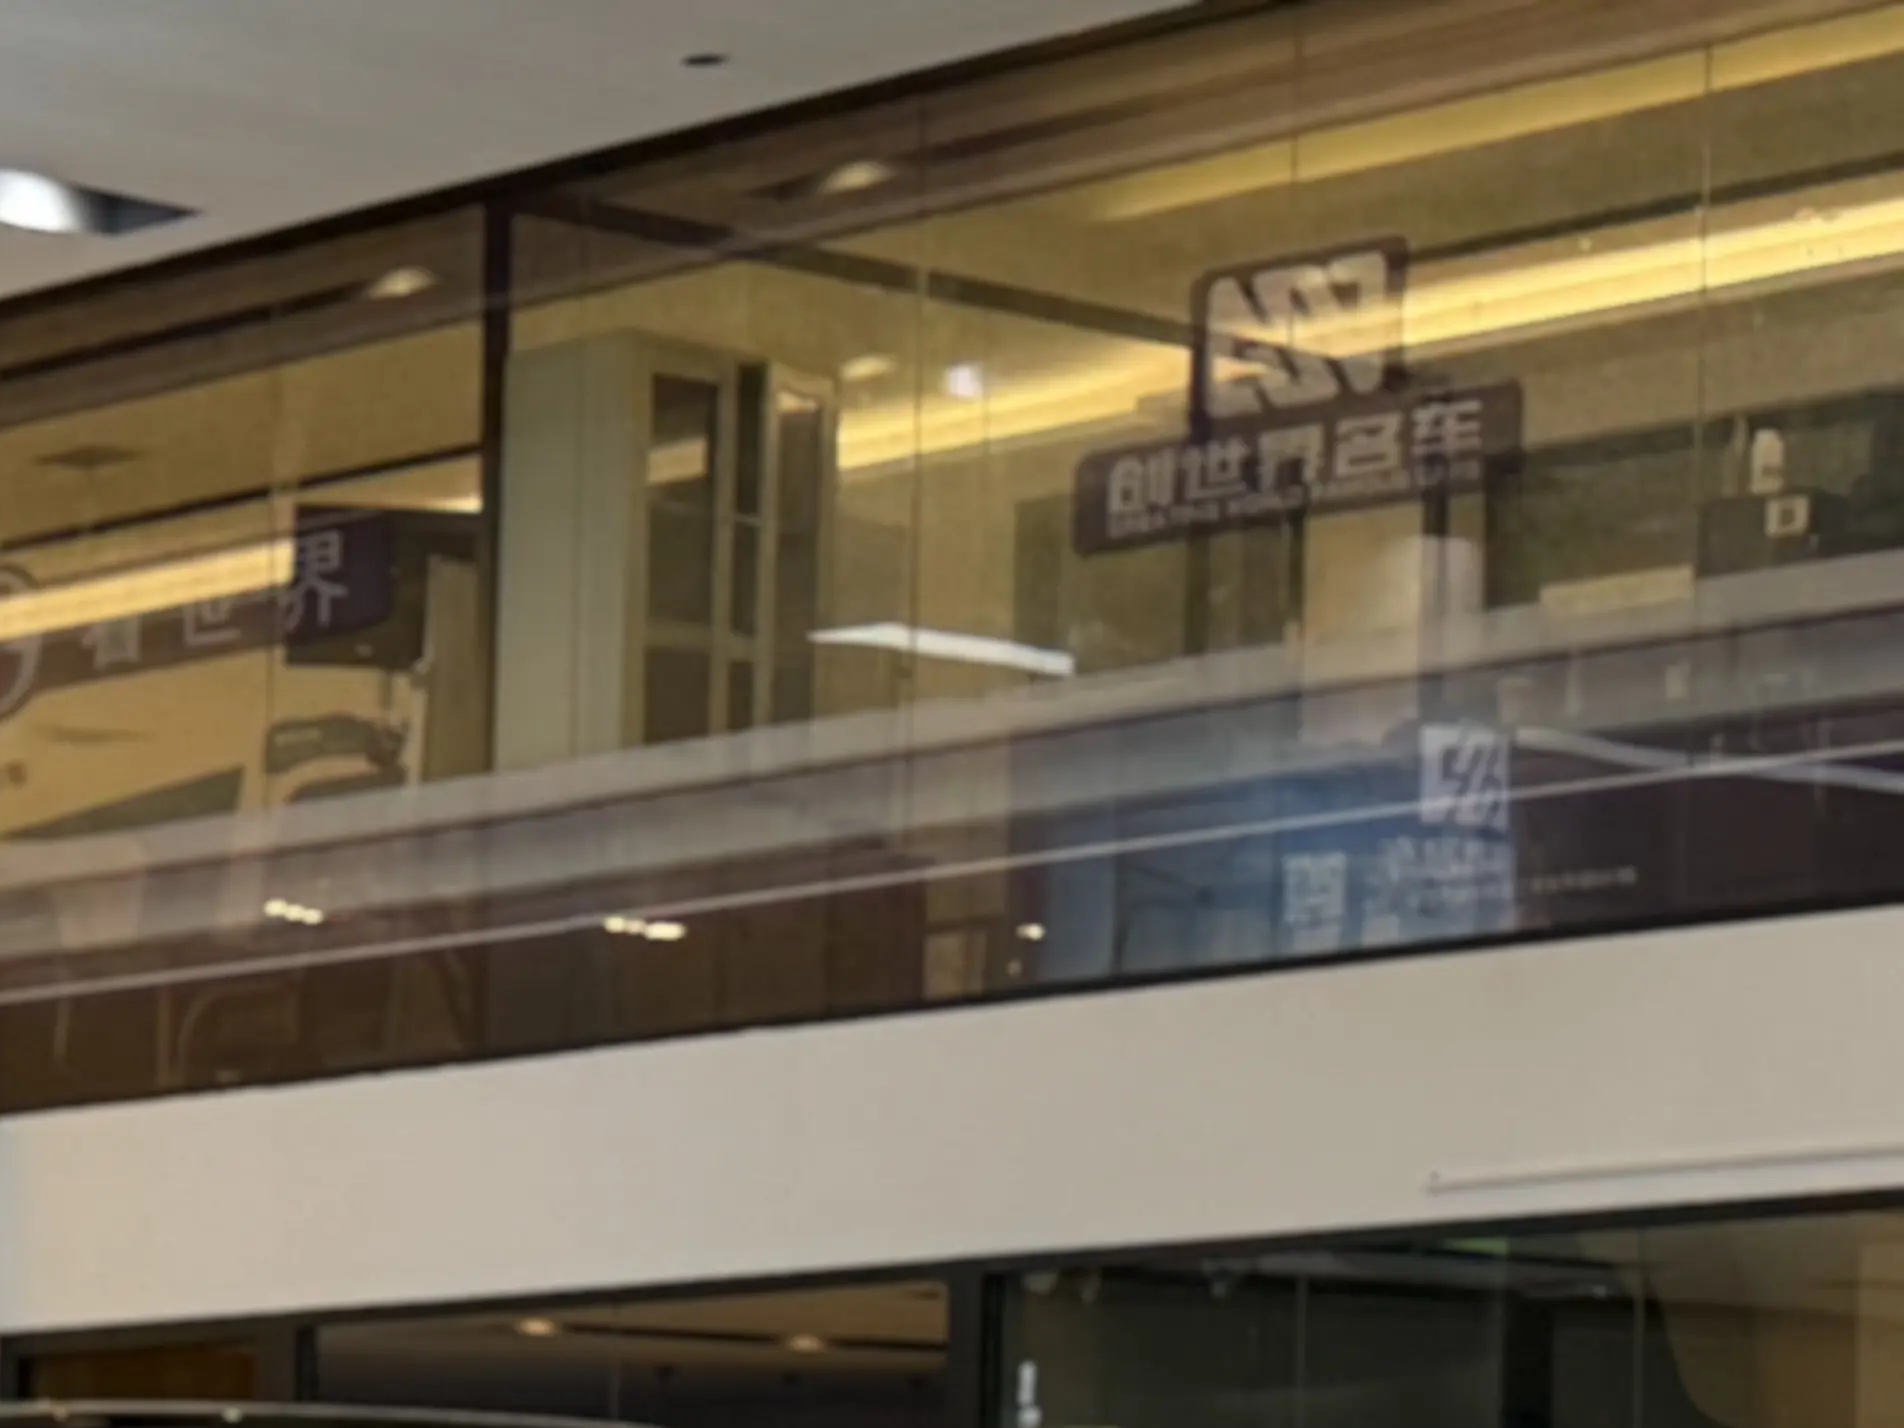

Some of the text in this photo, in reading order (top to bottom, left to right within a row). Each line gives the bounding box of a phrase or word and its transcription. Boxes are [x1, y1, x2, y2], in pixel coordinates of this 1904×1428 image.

[1106, 398, 1485, 516] 创世界名车
